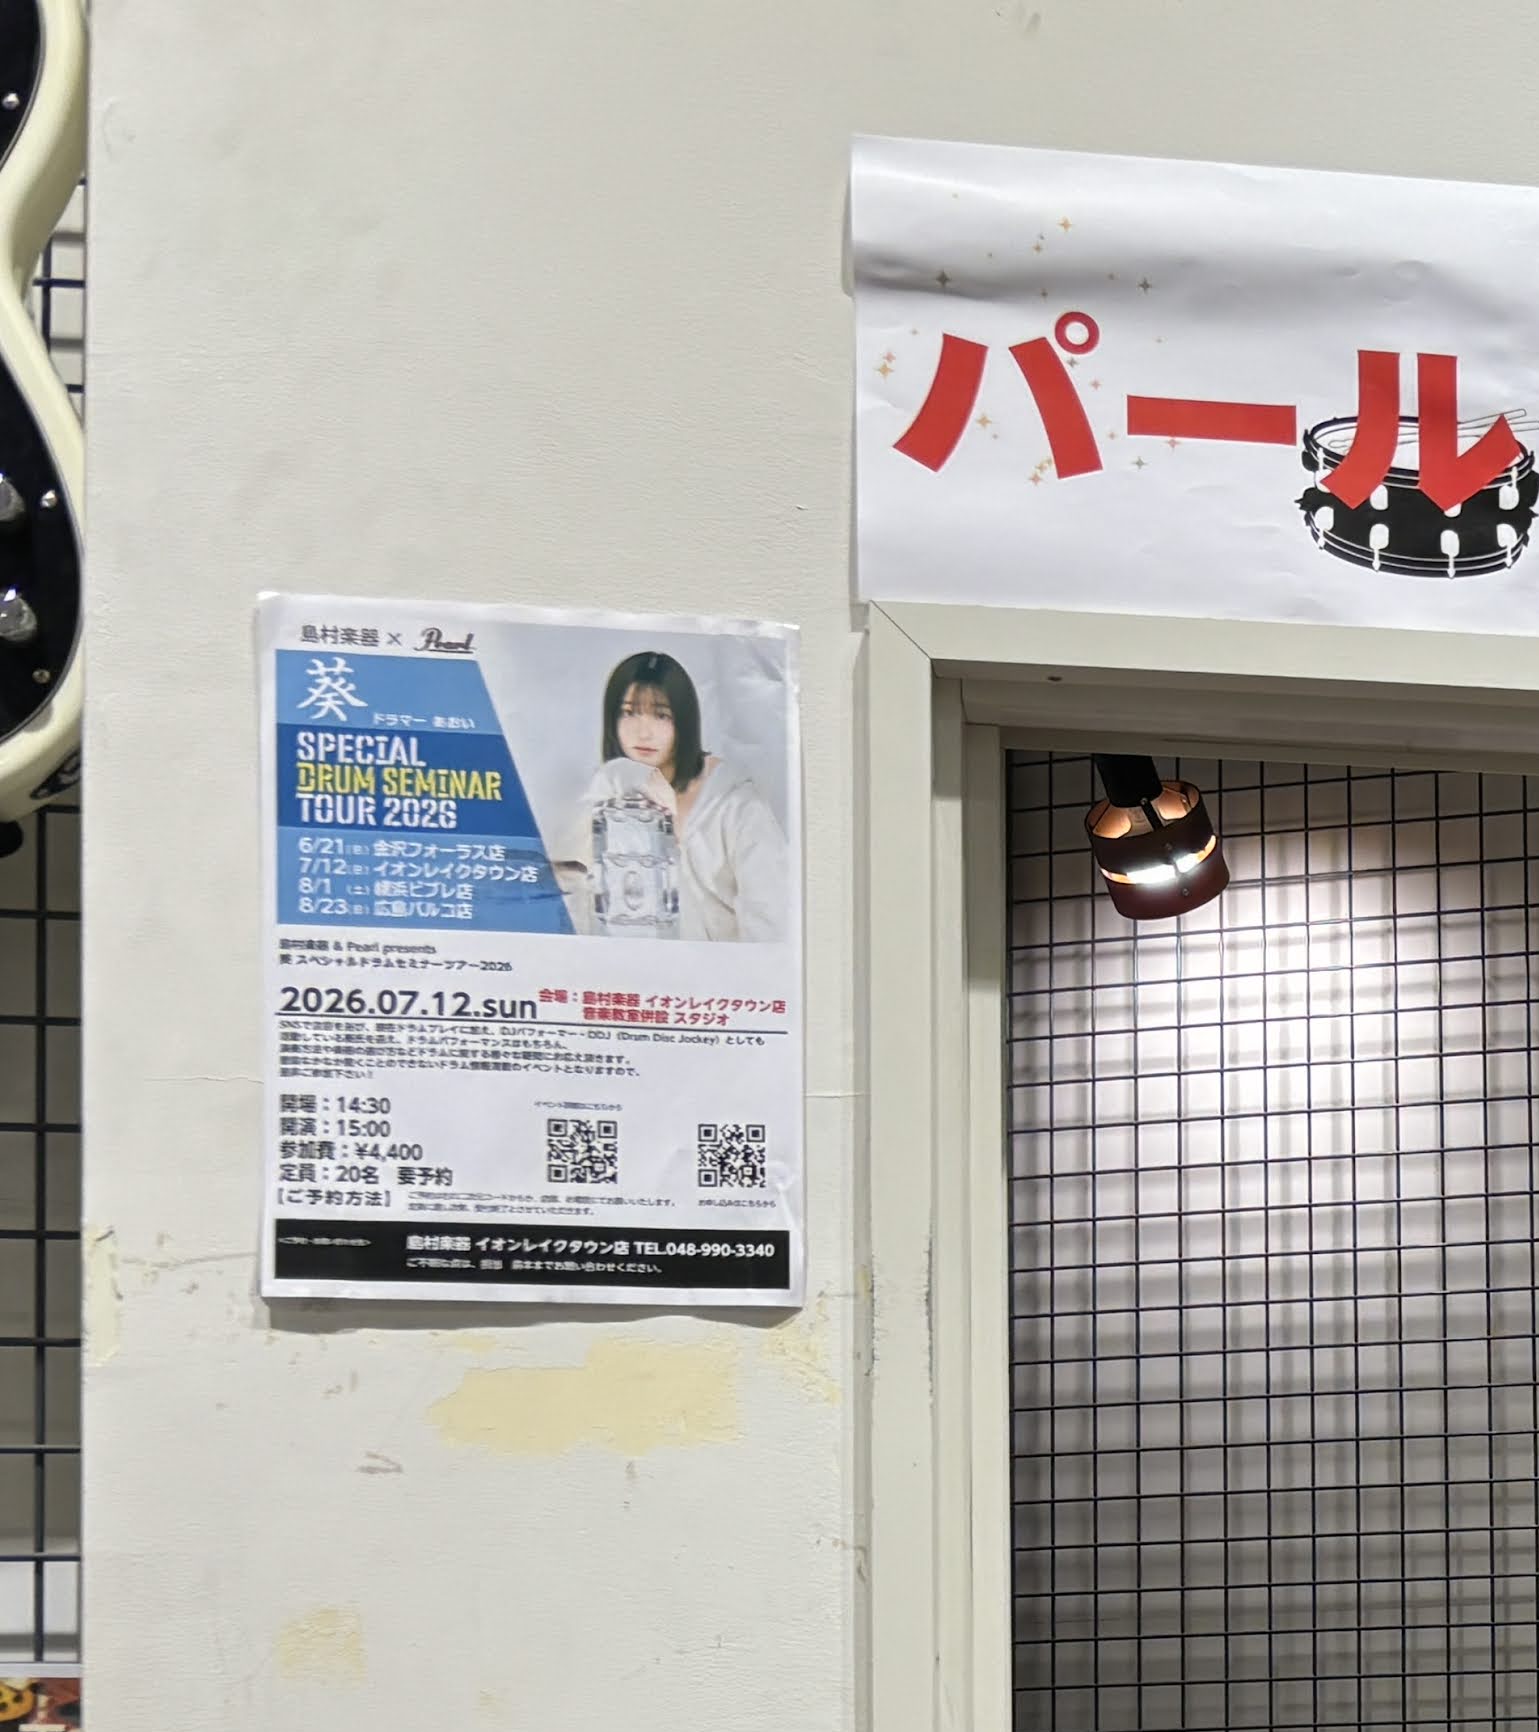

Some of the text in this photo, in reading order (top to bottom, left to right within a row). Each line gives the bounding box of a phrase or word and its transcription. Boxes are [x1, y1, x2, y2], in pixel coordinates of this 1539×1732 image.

[892, 310, 1522, 512] パール
[301, 625, 379, 647] 島村楽器
[297, 656, 369, 722] 葵
[373, 713, 475, 729] ドラマー あおい
[296, 731, 427, 767] SPECIAL
[296, 762, 502, 800] DRUM SEMINAR
[296, 793, 458, 829] TOUR 2026
[373, 840, 505, 861] 金沢フォーラス店
[373, 860, 539, 882] イオンレイクタウン店
[382, 943, 437, 957] presents
[281, 986, 537, 1019] 2026.07.12.sun
[645, 994, 786, 1013] イオンレイクタウン店
[674, 1011, 730, 1026] スタジオ
[397, 1167, 453, 1187] 要予約
[475, 1236, 629, 1256] イオンレイクタウン店
